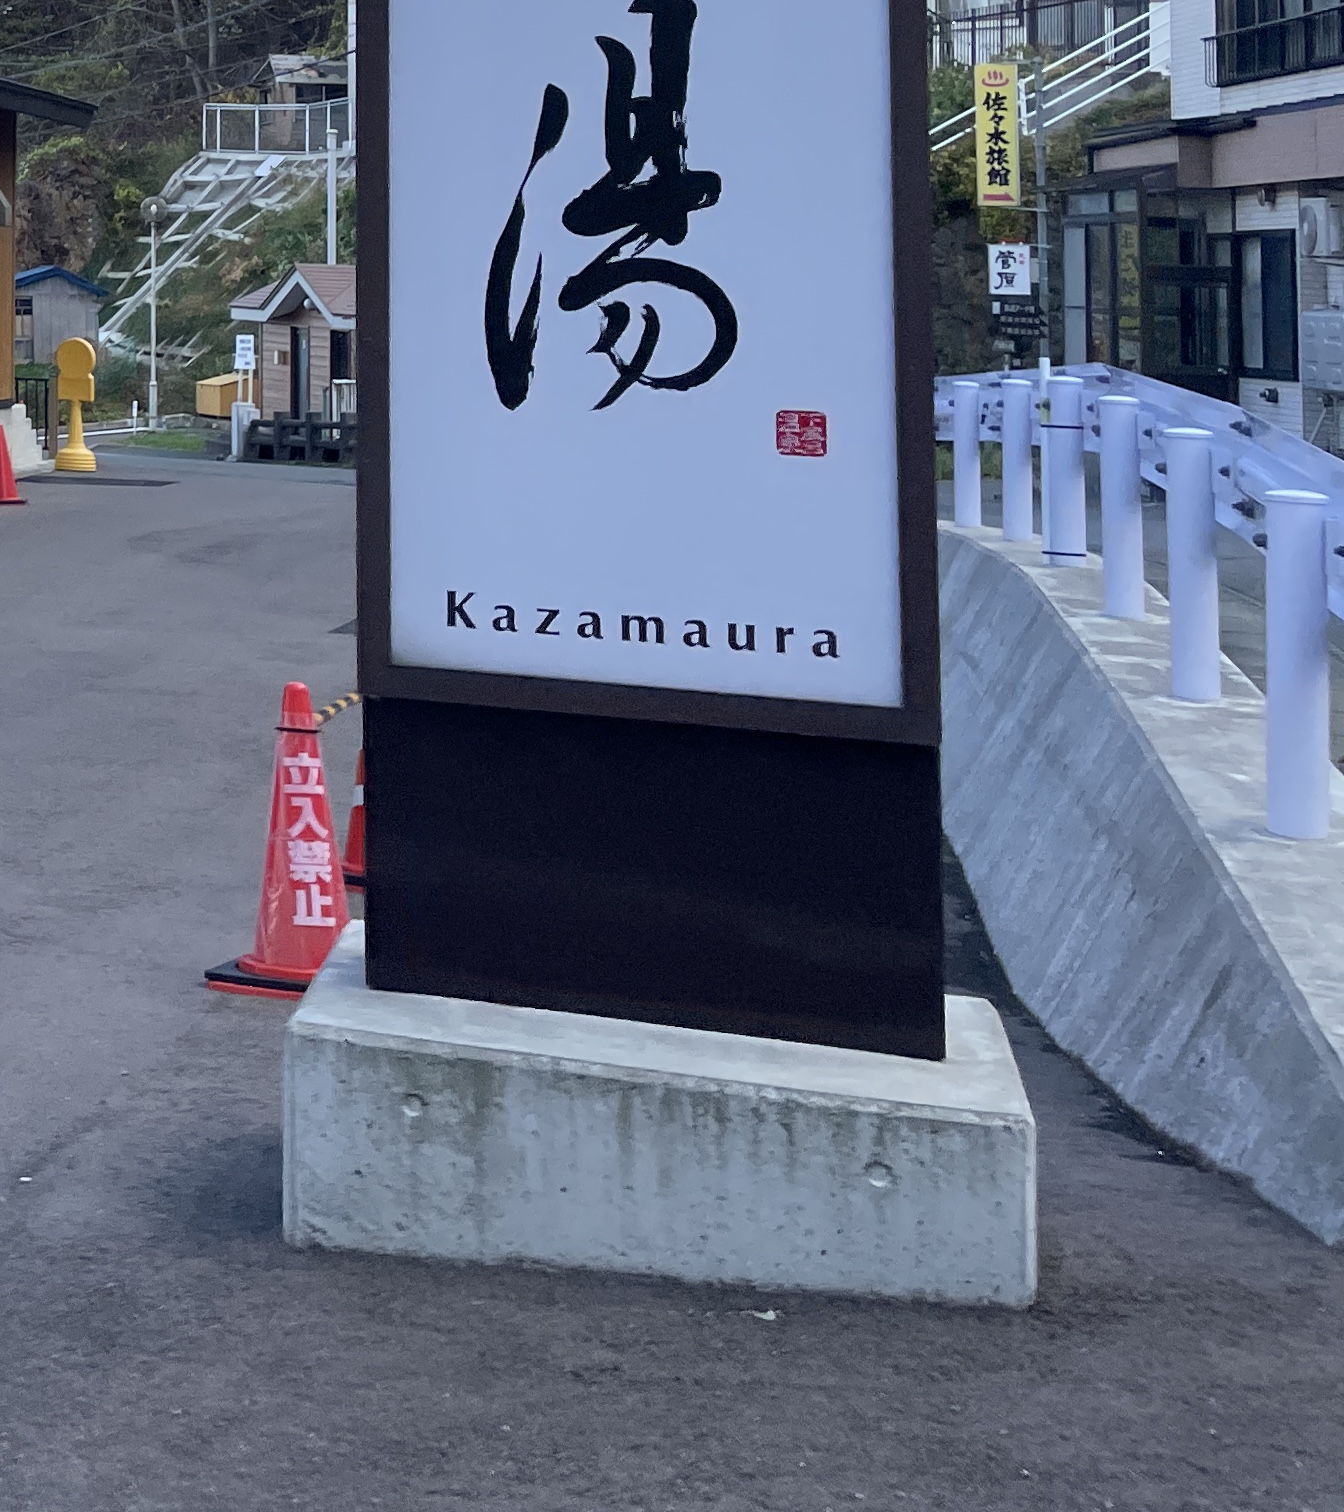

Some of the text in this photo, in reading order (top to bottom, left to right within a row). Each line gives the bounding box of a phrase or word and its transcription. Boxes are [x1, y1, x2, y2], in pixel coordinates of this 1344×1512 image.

[983, 91, 1012, 187] 佐々木旅館
[445, 589, 841, 659] Kazamaura
[282, 752, 337, 928] 立入禁止
